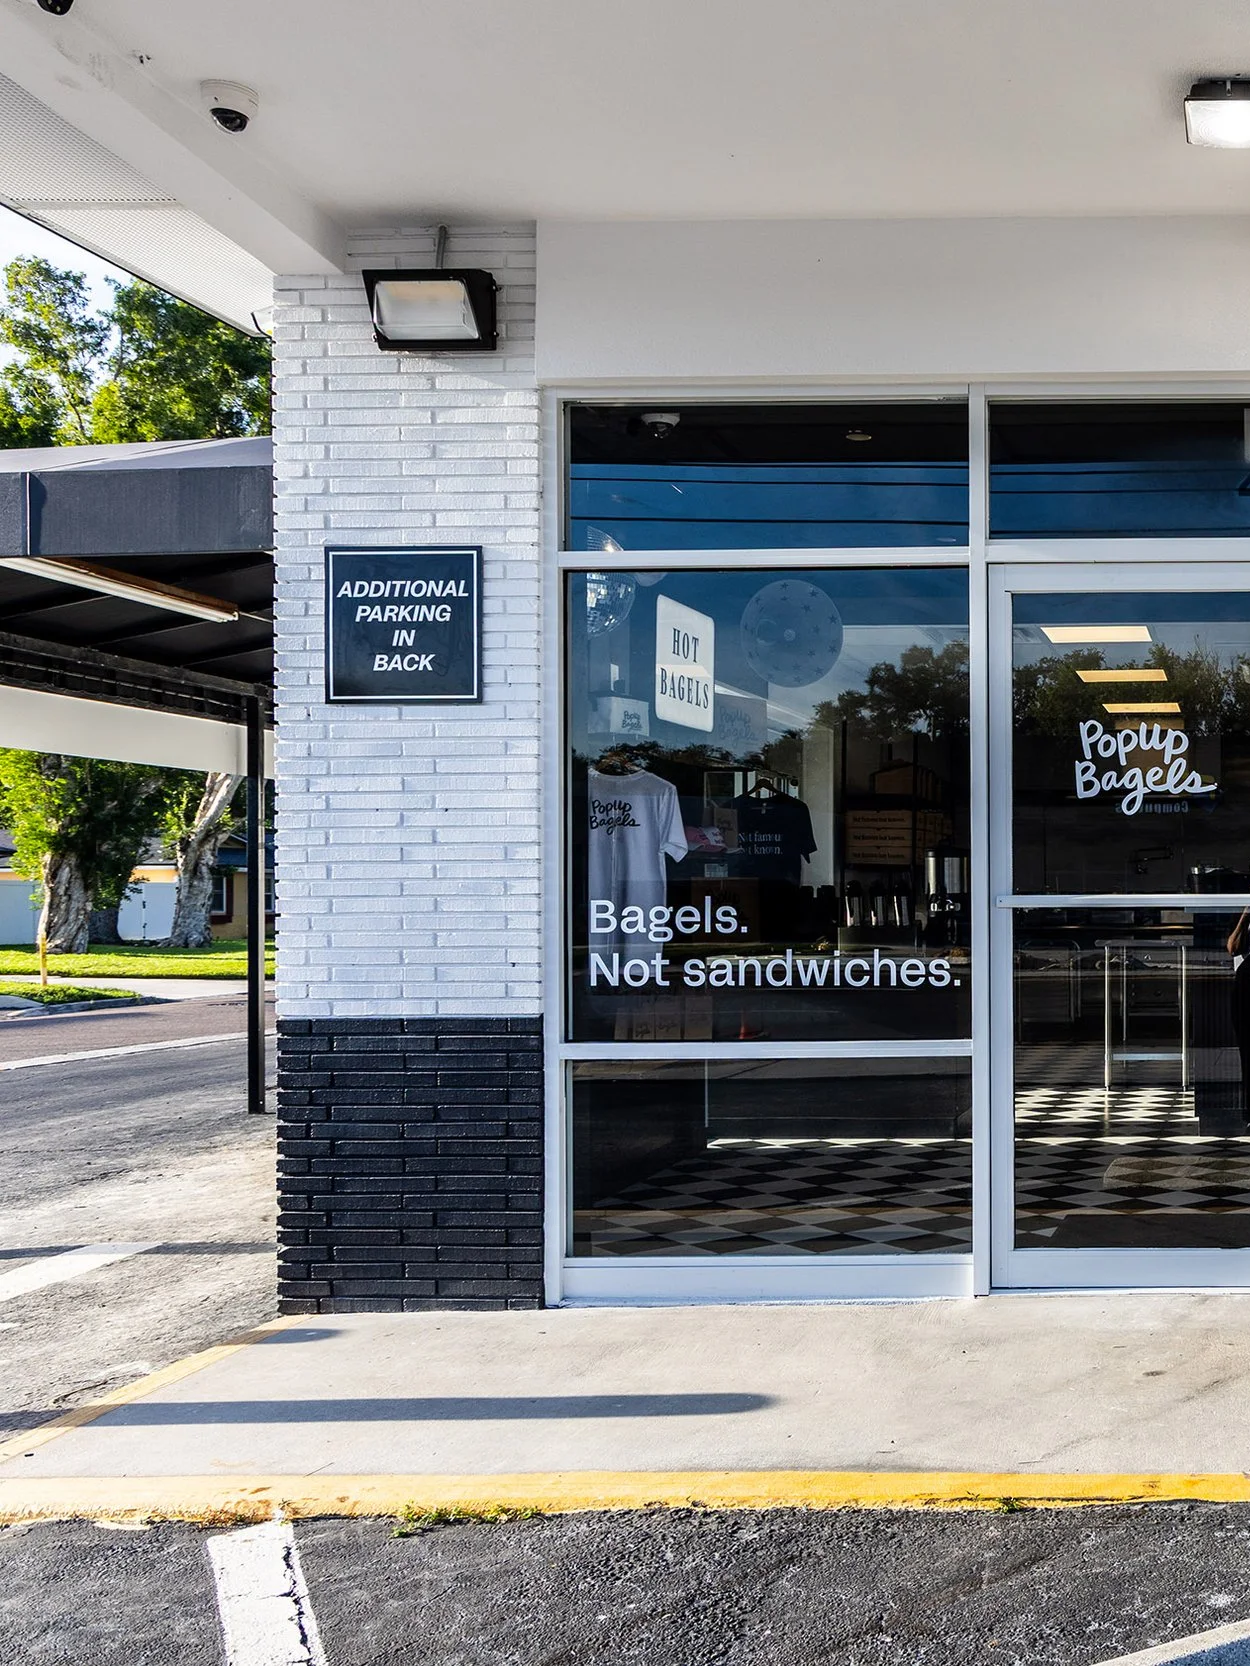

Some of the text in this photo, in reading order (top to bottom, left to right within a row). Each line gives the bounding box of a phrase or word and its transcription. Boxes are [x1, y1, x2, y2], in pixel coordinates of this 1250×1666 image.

[336, 580, 469, 598] ADDITIONAL
[355, 604, 451, 622] PARKING
[392, 629, 415, 647] IN
[672, 627, 699, 663] HOT
[372, 654, 435, 671] BACK
[660, 667, 709, 709] BAGELS
[1078, 719, 1189, 767] PopUp
[1074, 758, 1217, 816] Bagels
[592, 800, 632, 816] PopUp
[590, 813, 641, 835] Bagels
[590, 896, 748, 942] Bagels.
[590, 948, 961, 987] Not sandwiches.
